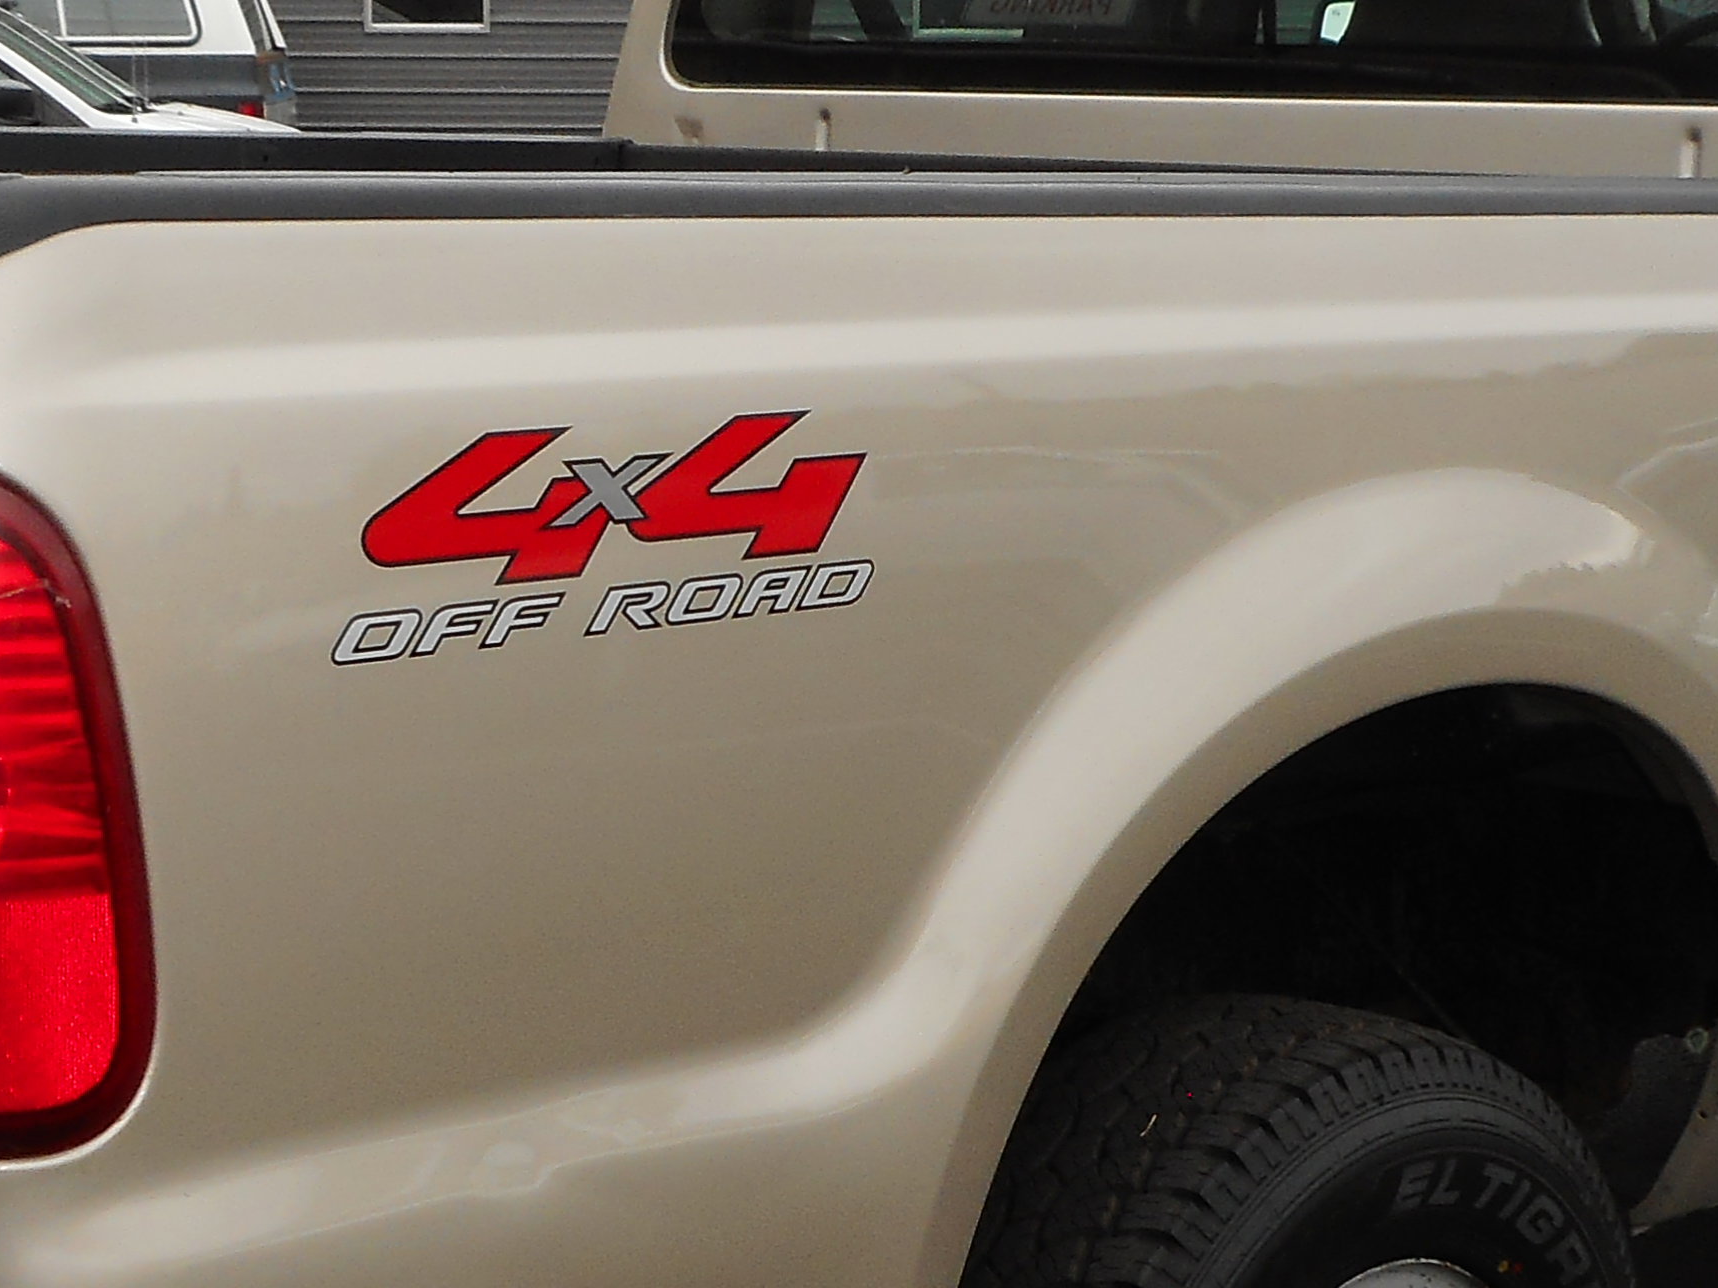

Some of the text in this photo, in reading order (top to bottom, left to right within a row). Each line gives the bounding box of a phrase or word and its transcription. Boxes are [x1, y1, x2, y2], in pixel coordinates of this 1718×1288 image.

[329, 558, 877, 667] OFF ROAD
[1391, 1156, 1461, 1212] EL
